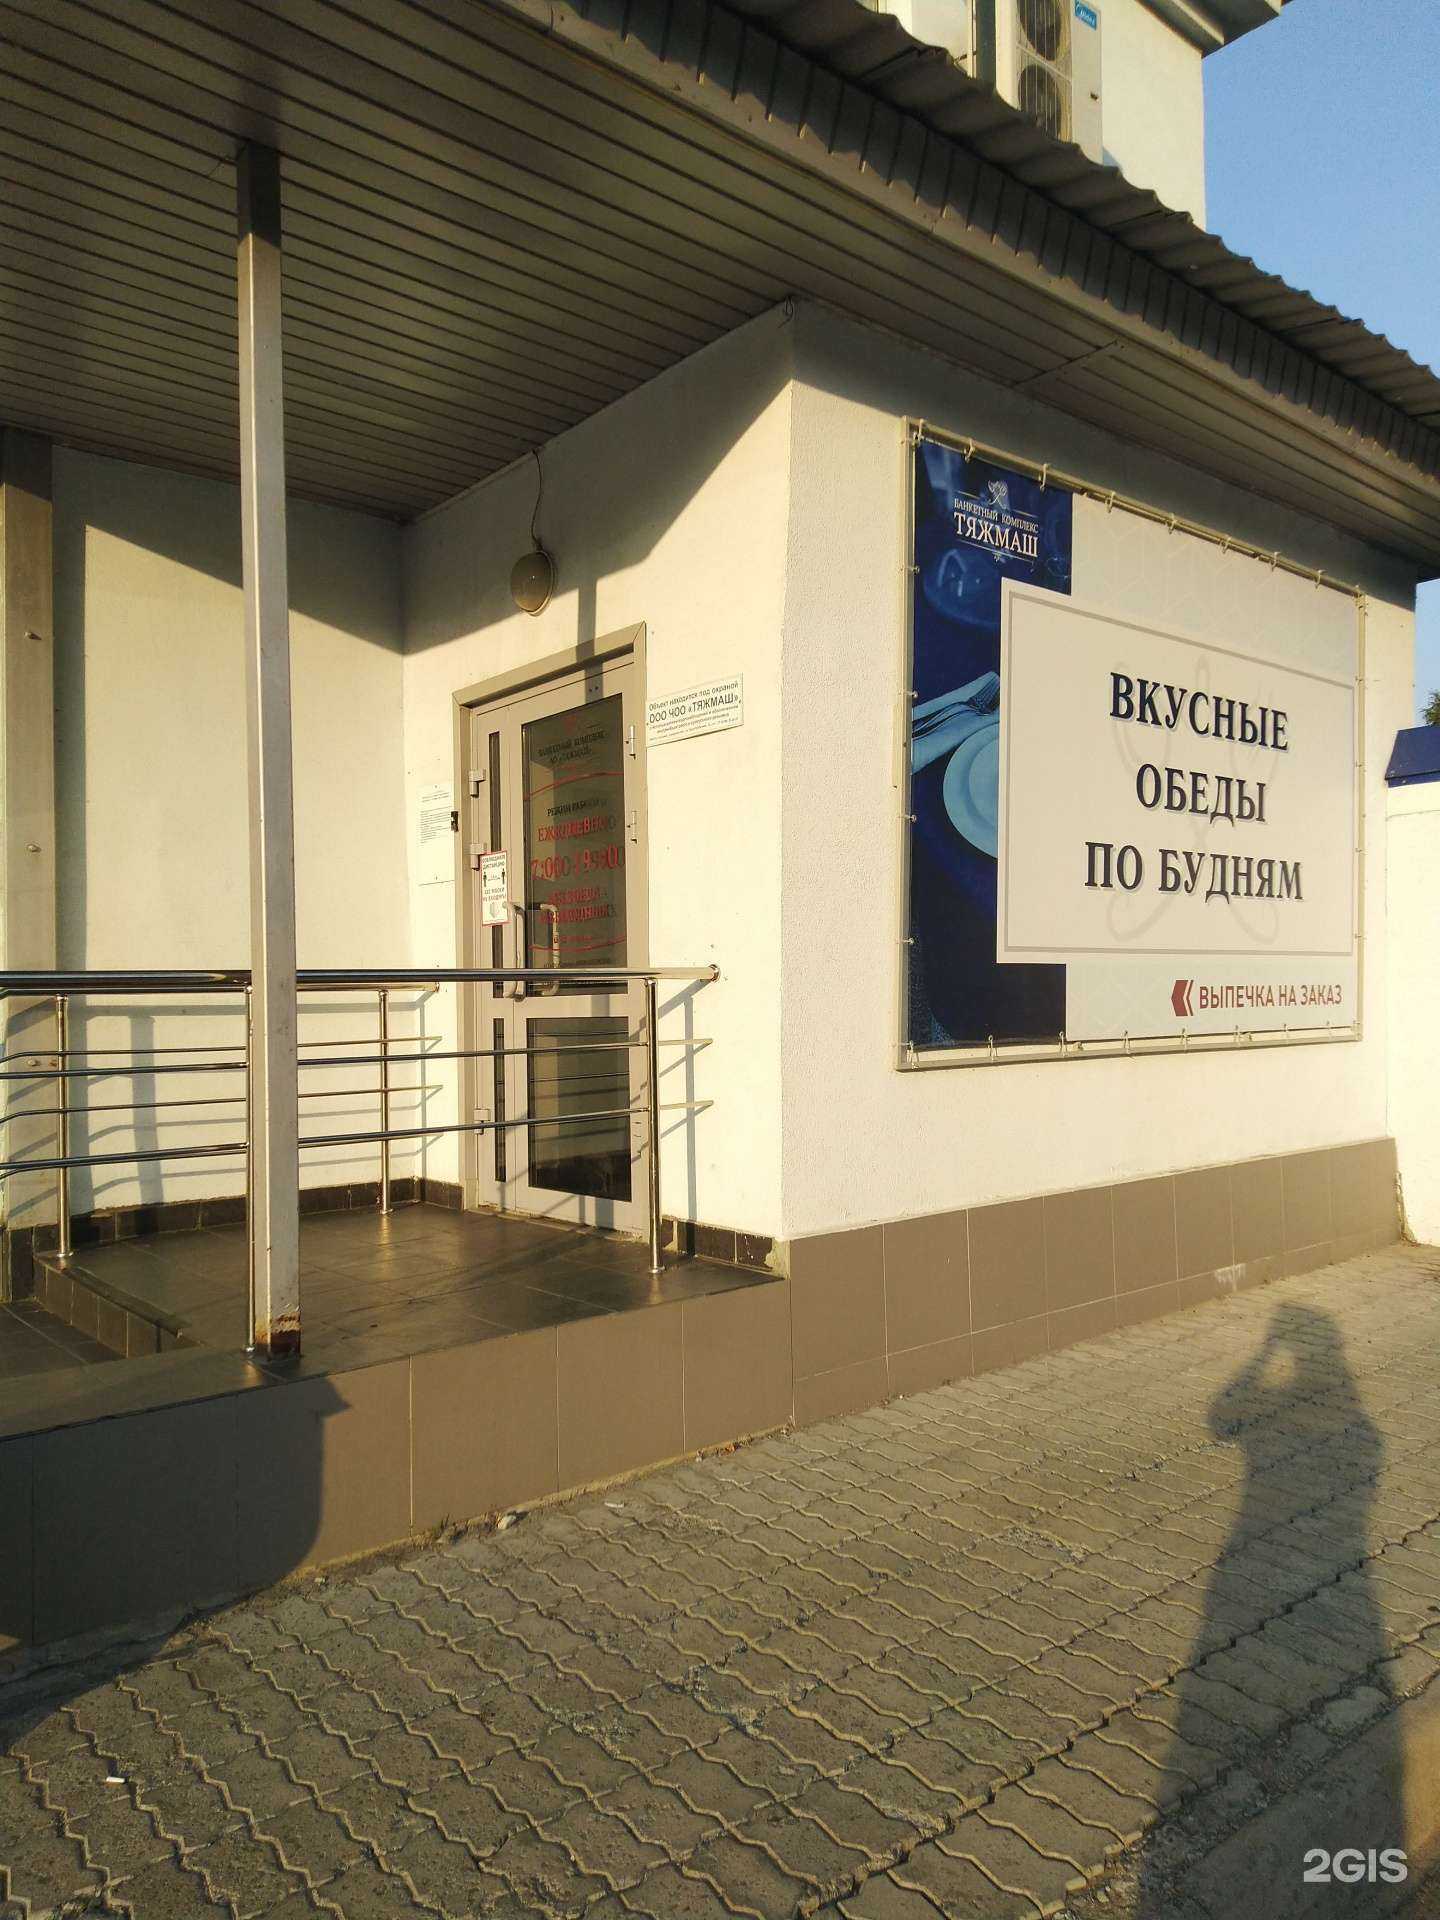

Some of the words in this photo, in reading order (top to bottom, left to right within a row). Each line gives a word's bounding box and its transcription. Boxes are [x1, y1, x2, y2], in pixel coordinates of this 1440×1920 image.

[953, 512, 1039, 558] ТЯЖМАШ
[954, 498, 998, 521] БАНКЕТНЫЙ
[1001, 512, 1039, 533] КОМПЛЕКС
[649, 710, 667, 724] ООО
[668, 704, 686, 718] ЧОО
[1110, 672, 1289, 751] ВКУСНЫЕ
[1136, 763, 1266, 827] ОБЕДЫ
[1084, 841, 1143, 890] ПО
[1158, 848, 1303, 905] БУДНЯМ
[1199, 985, 1275, 1009] ВЫПЕЧКА
[1278, 985, 1297, 1007] НА
[1300, 984, 1342, 1006] ЗАКАЗ
